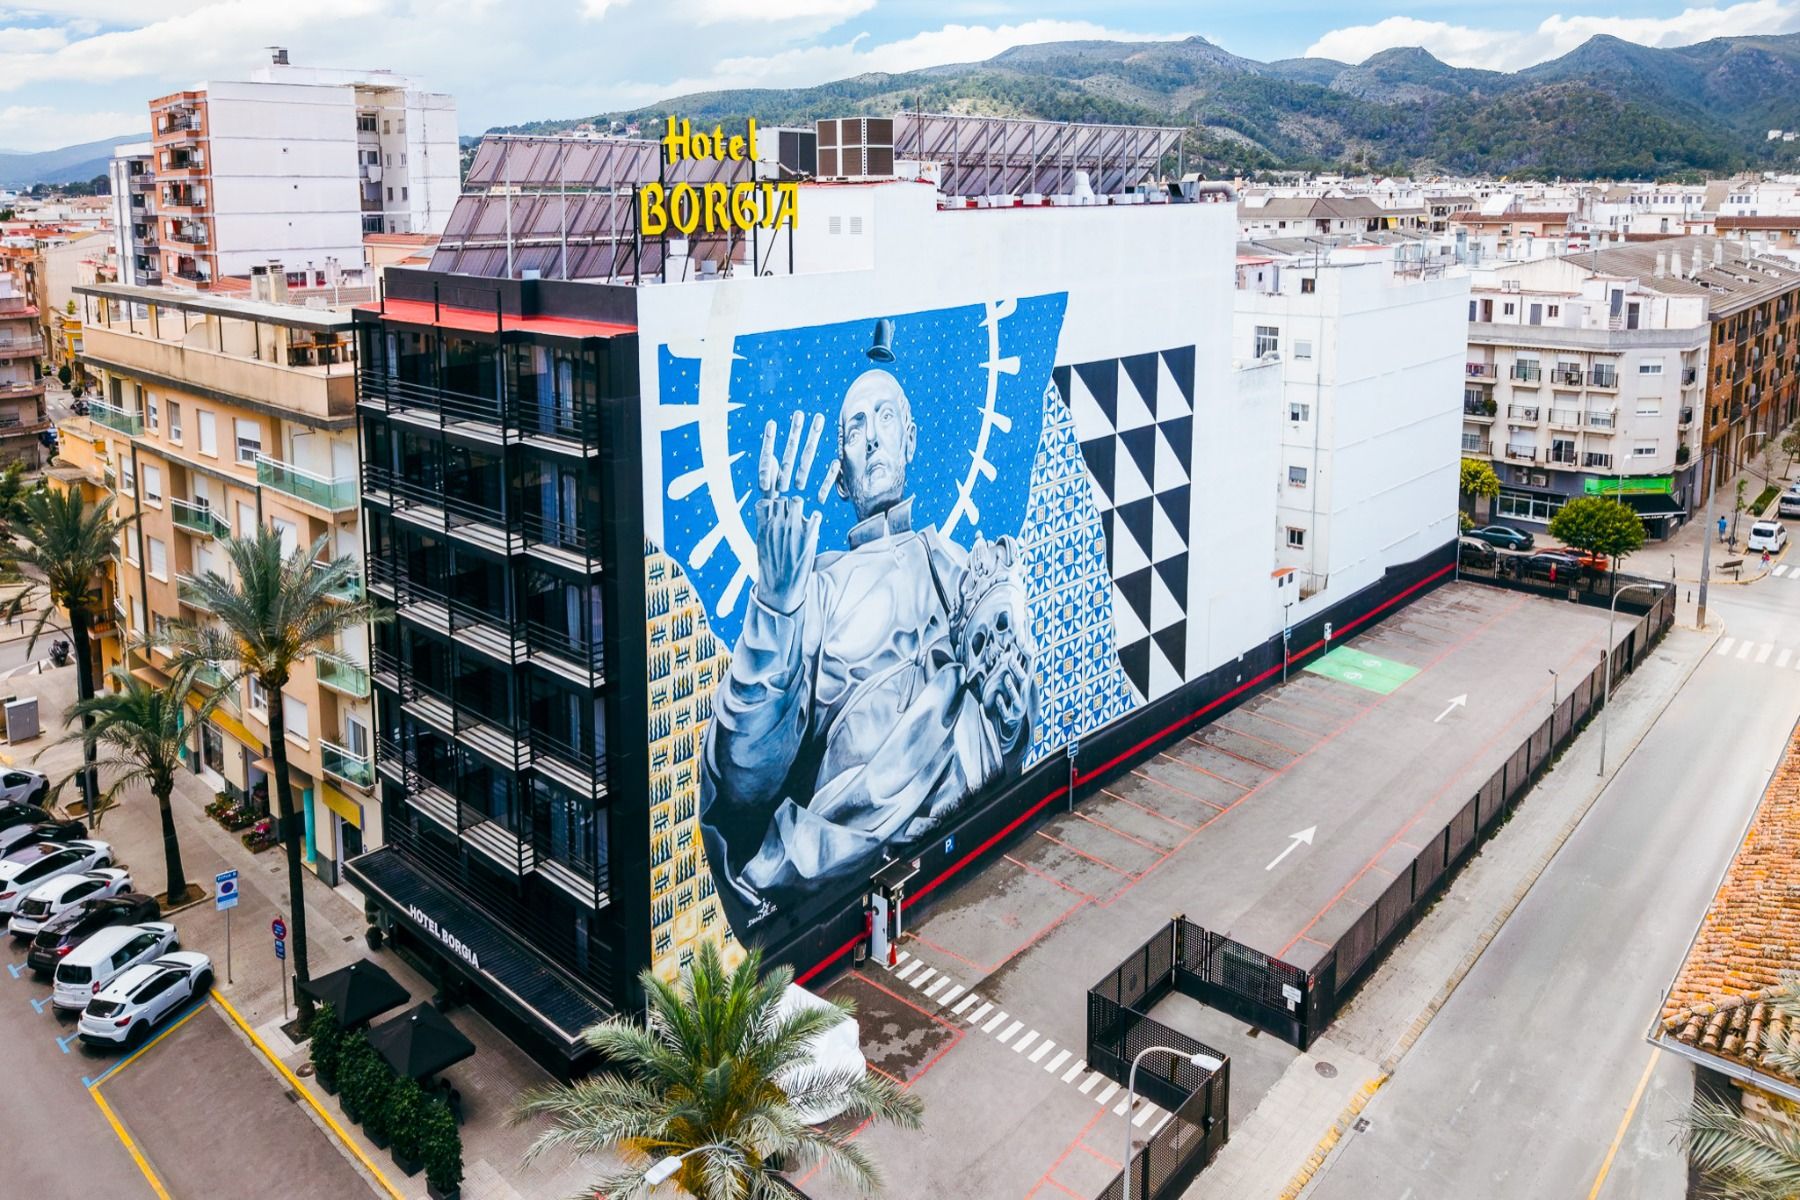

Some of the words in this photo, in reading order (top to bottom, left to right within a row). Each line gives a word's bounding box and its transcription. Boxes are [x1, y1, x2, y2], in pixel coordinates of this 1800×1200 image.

[662, 115, 759, 165] Hotel
[409, 904, 441, 938] HOTEL
[441, 927, 479, 969] BORGIA
